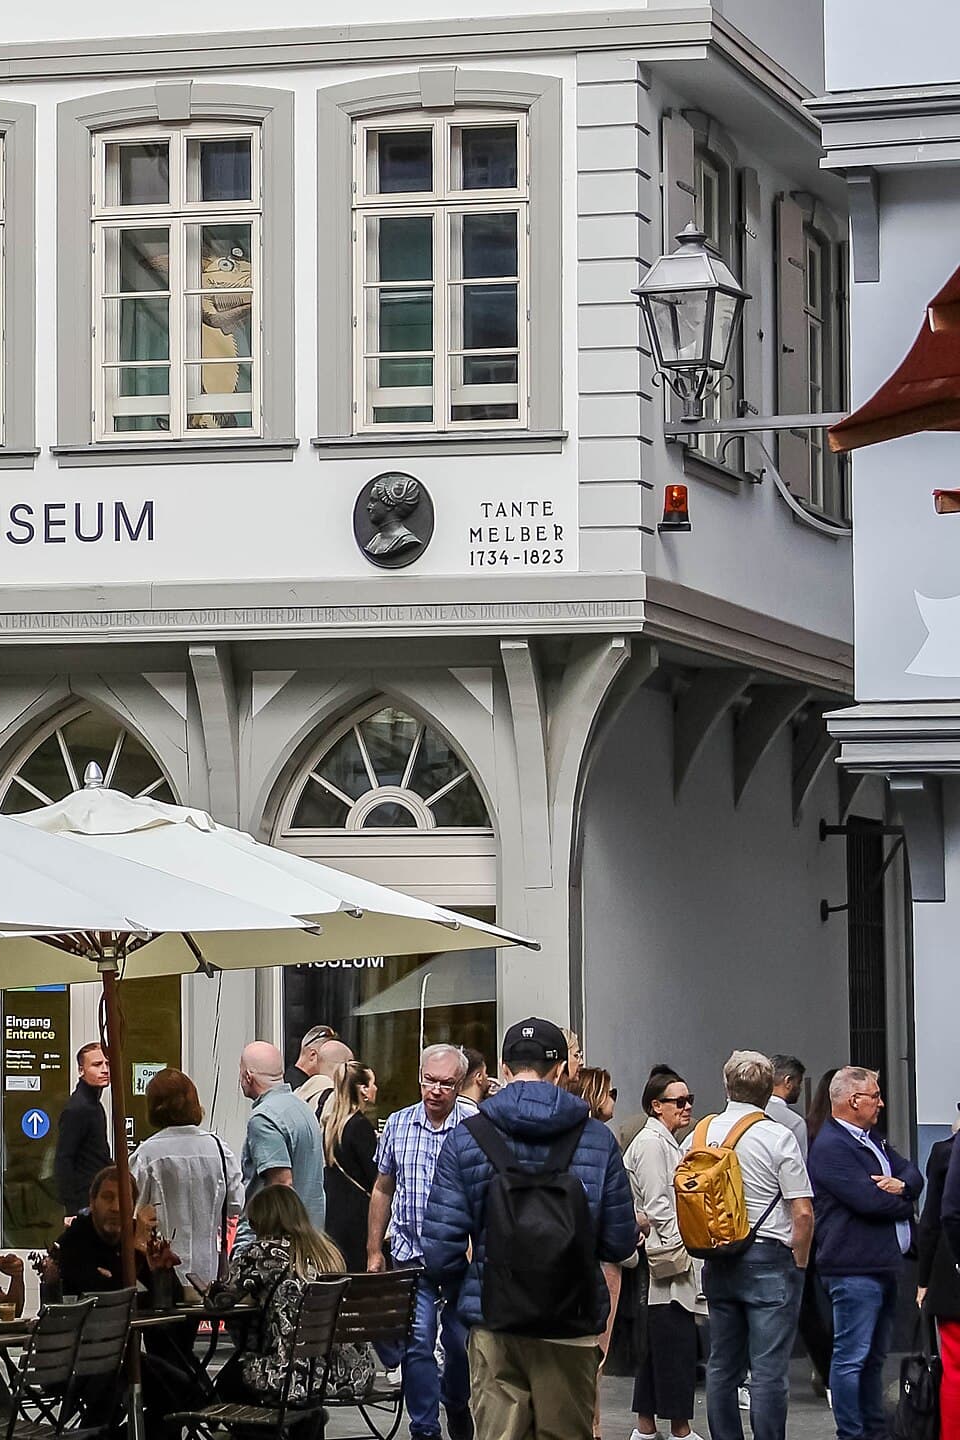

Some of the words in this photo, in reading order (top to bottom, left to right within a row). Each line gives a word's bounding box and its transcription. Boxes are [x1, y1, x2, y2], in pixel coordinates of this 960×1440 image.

[480, 501, 554, 518] TANTE
[469, 524, 564, 543] MELBER
[470, 549, 564, 566] 1734-1823
[409, 606, 448, 620] TANTE
[450, 605, 477, 620] AUS
[6, 1016, 51, 1029] Eingang
[6, 1029, 56, 1040] Entrance
